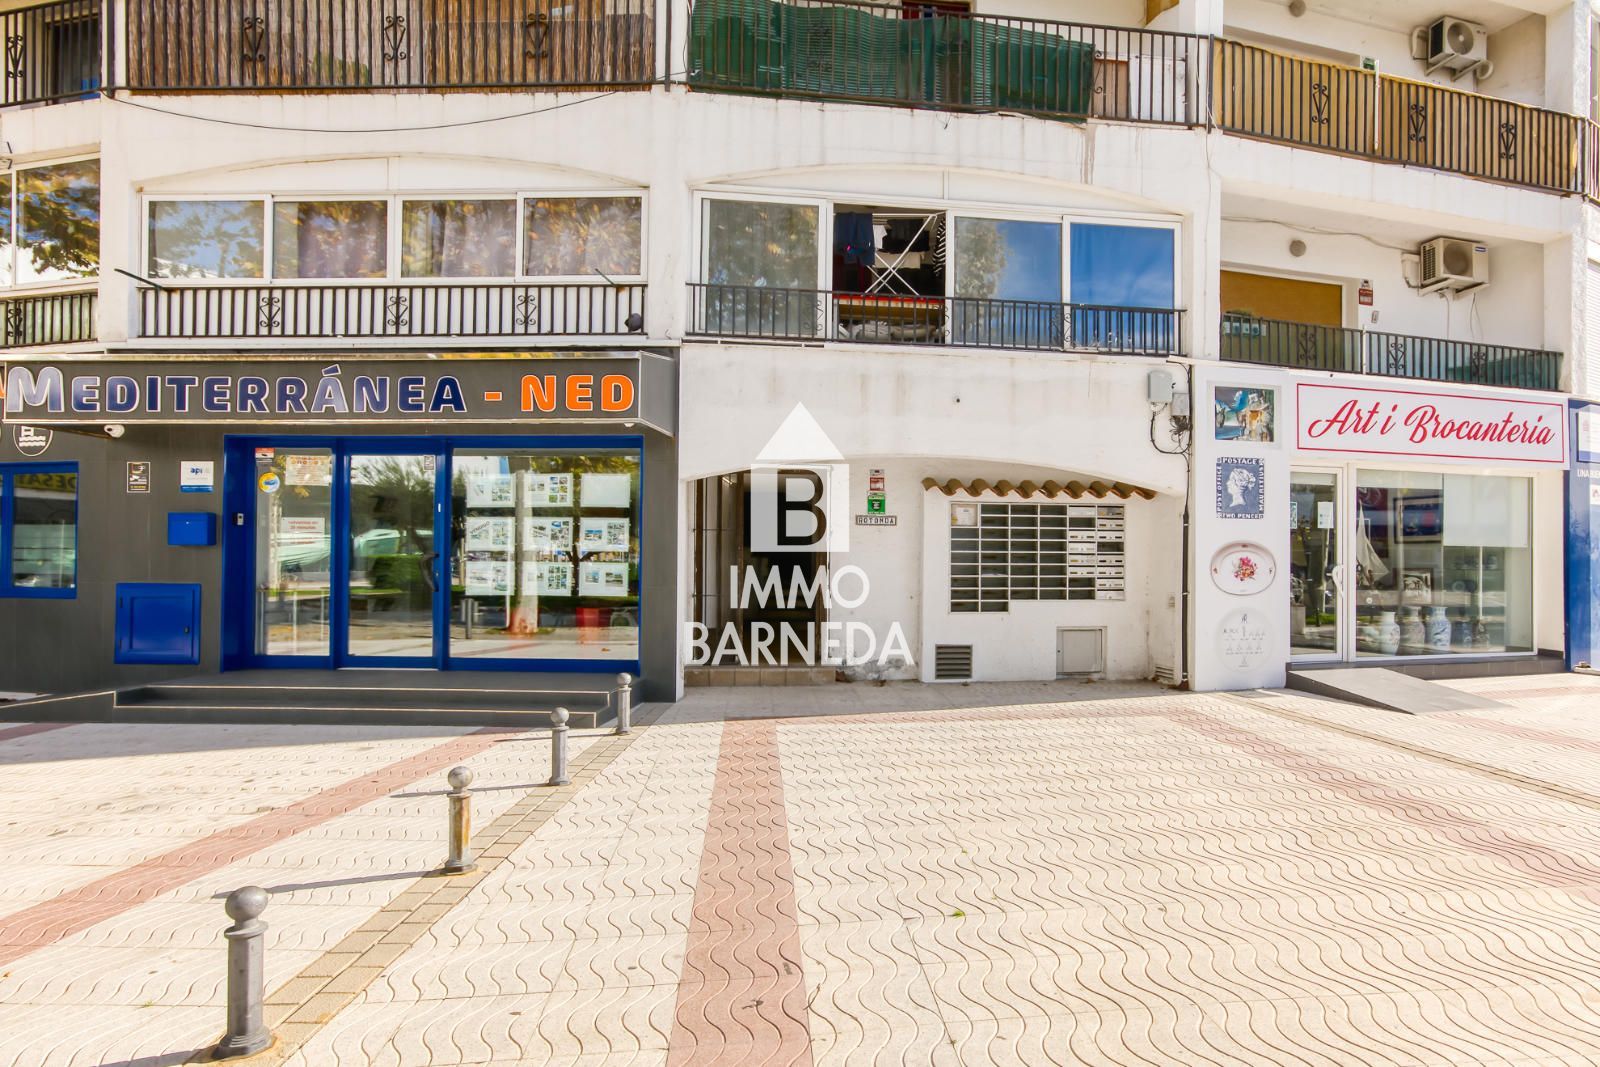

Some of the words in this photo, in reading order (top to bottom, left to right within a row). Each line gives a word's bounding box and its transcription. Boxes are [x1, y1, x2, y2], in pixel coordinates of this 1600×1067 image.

[6, 364, 467, 413] MEDITERRÁNEA
[520, 374, 635, 412] NED
[1308, 400, 1378, 438] Art
[1380, 403, 1398, 435] i
[1403, 404, 1555, 445] Brocanteria
